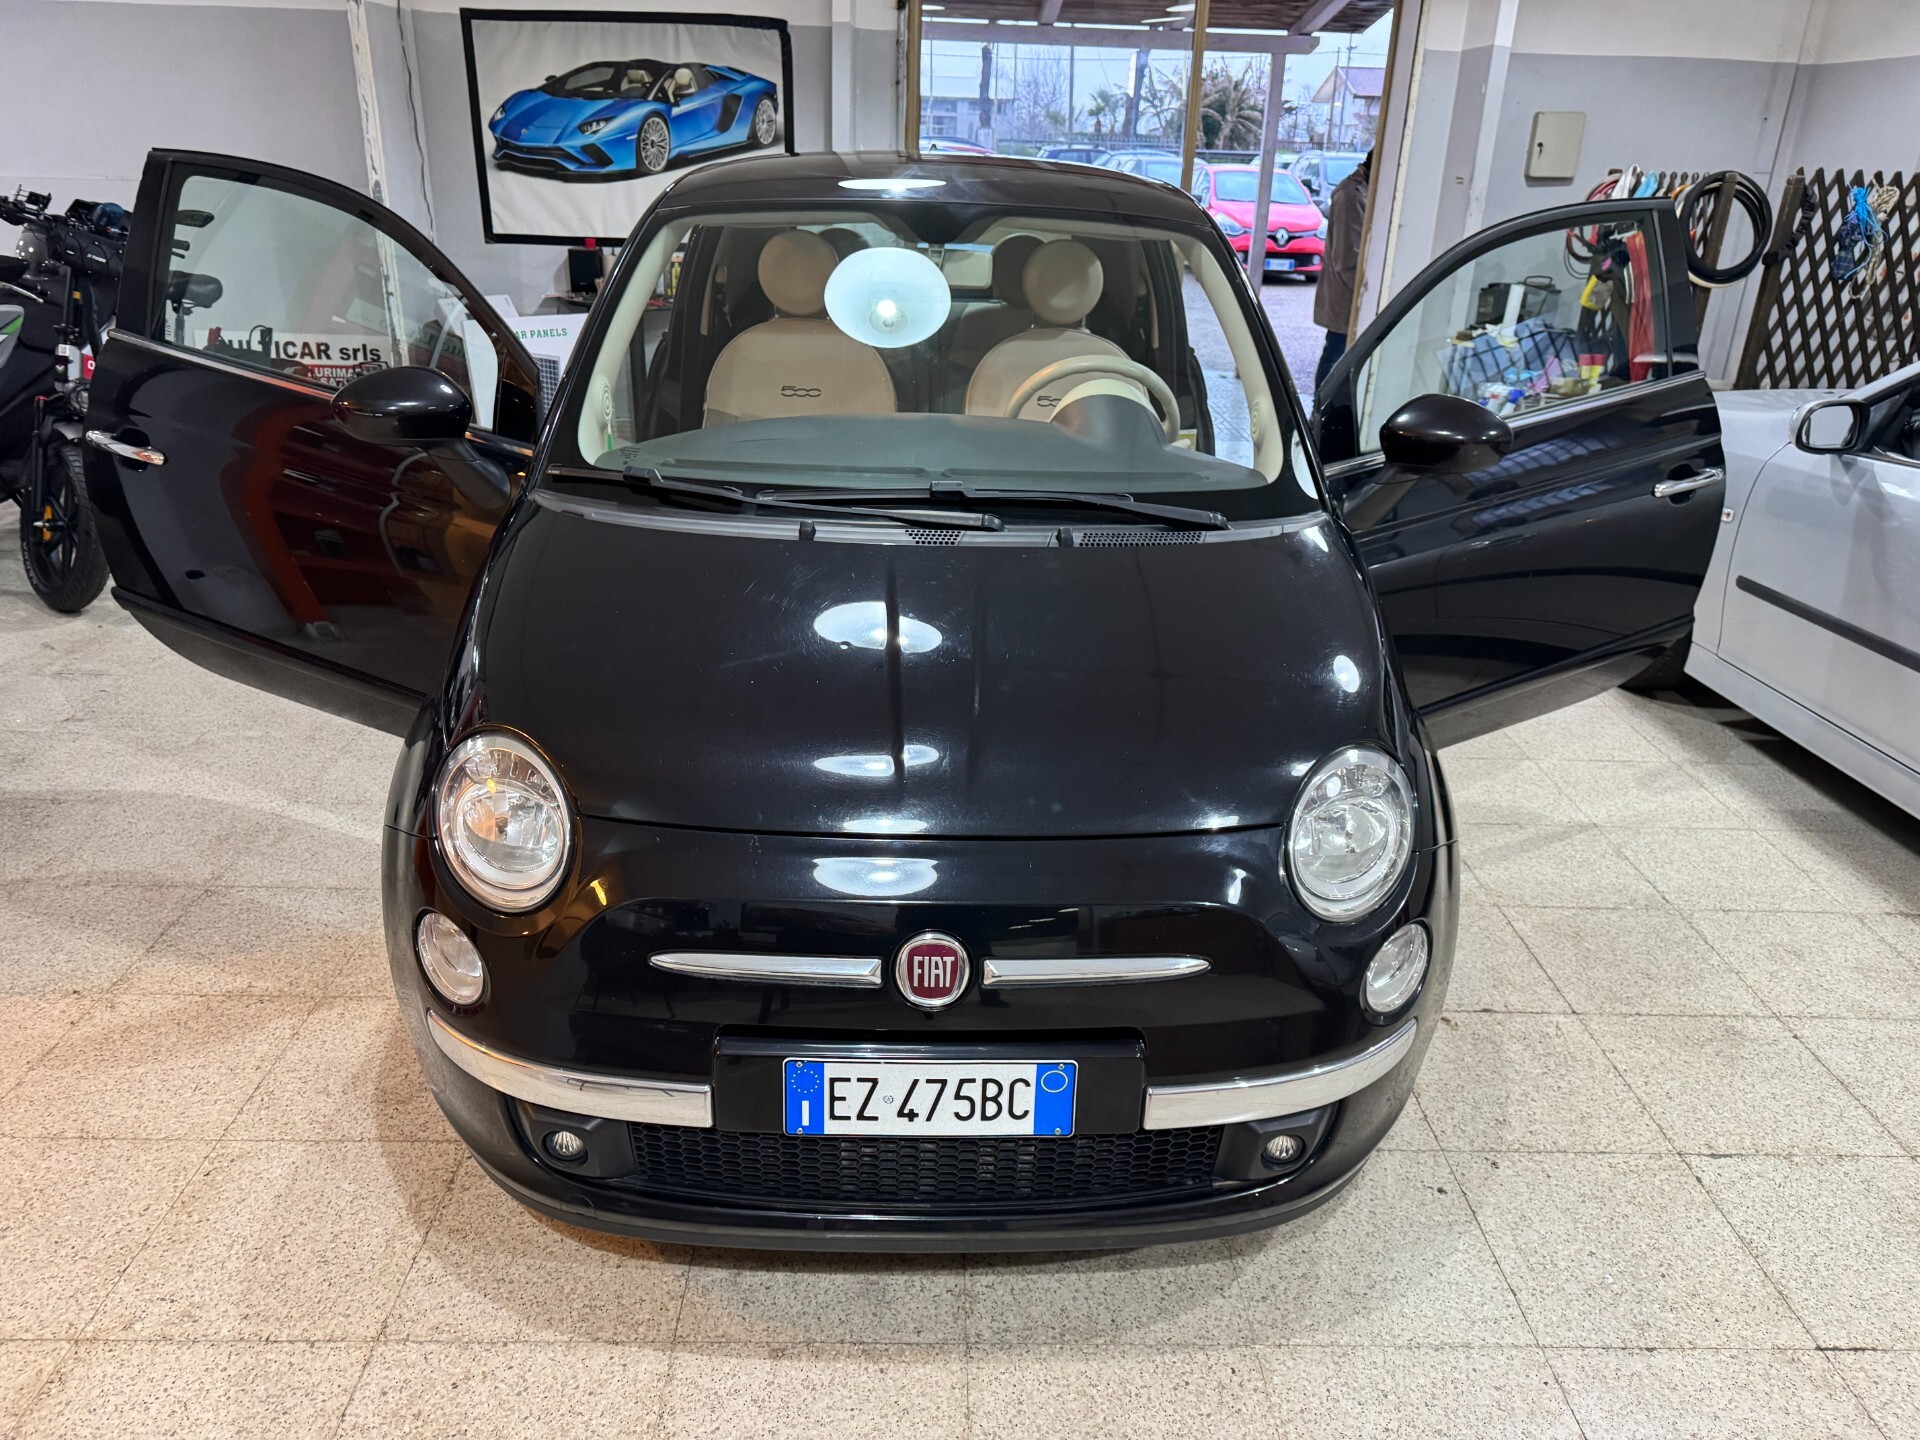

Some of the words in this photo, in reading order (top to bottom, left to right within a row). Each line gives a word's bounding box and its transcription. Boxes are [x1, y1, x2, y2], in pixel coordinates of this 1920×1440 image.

[529, 327, 568, 339] PANELS
[339, 344, 382, 361] srls
[780, 385, 822, 398] 500
[913, 956, 955, 988] FIAT
[828, 1077, 880, 1122] EZ
[896, 1077, 1031, 1122] 475BC
